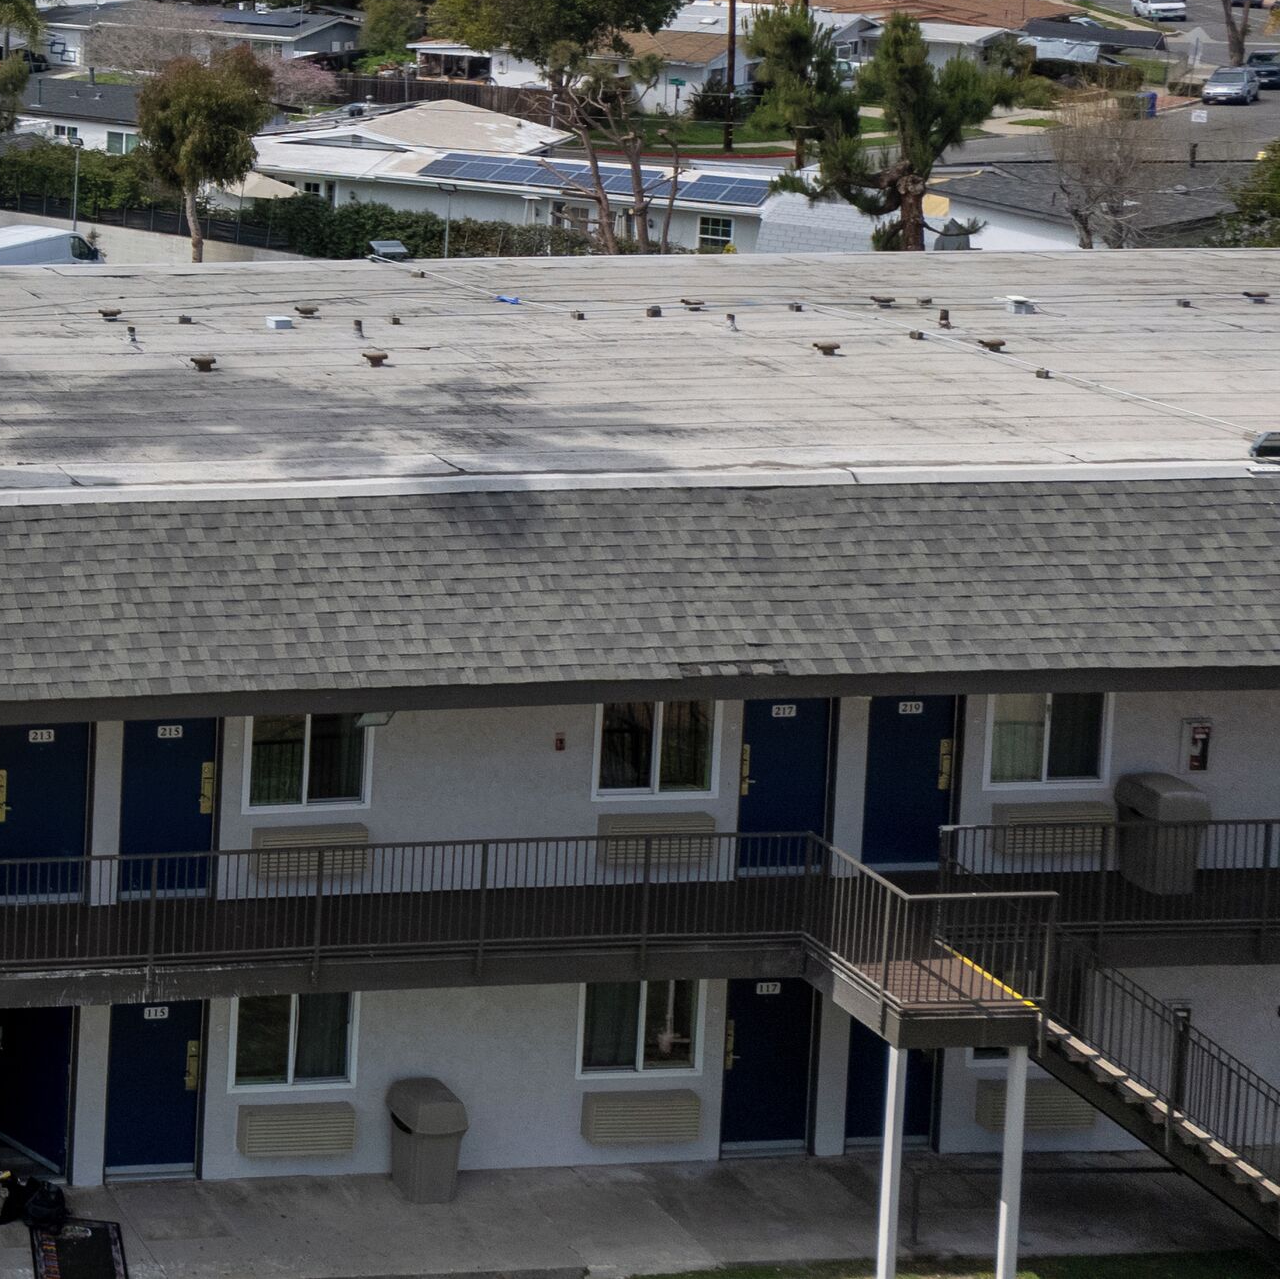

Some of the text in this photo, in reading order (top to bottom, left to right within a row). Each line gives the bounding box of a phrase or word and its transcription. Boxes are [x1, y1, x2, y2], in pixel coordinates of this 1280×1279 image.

[774, 706, 794, 716] 217
[901, 703, 921, 713] 219
[31, 730, 52, 741] 213
[159, 727, 181, 737] 215
[759, 983, 778, 993] 117
[146, 1007, 166, 1018] 115
